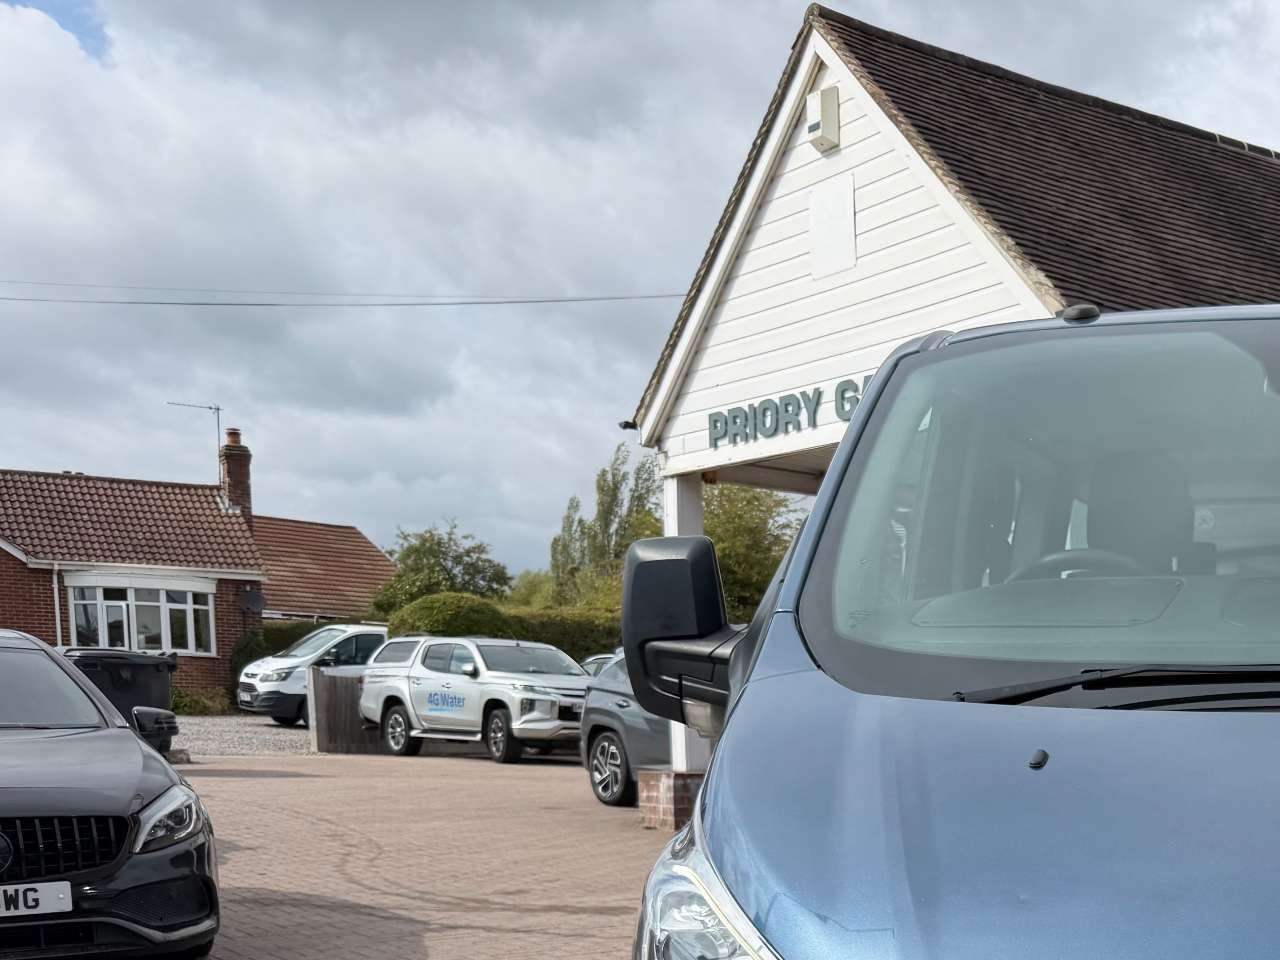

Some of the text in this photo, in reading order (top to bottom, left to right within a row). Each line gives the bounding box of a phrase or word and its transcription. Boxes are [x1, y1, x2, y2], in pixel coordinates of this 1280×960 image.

[708, 374, 874, 450] PRIORY G
[440, 692, 466, 708] Water
[0, 887, 40, 912] WG
